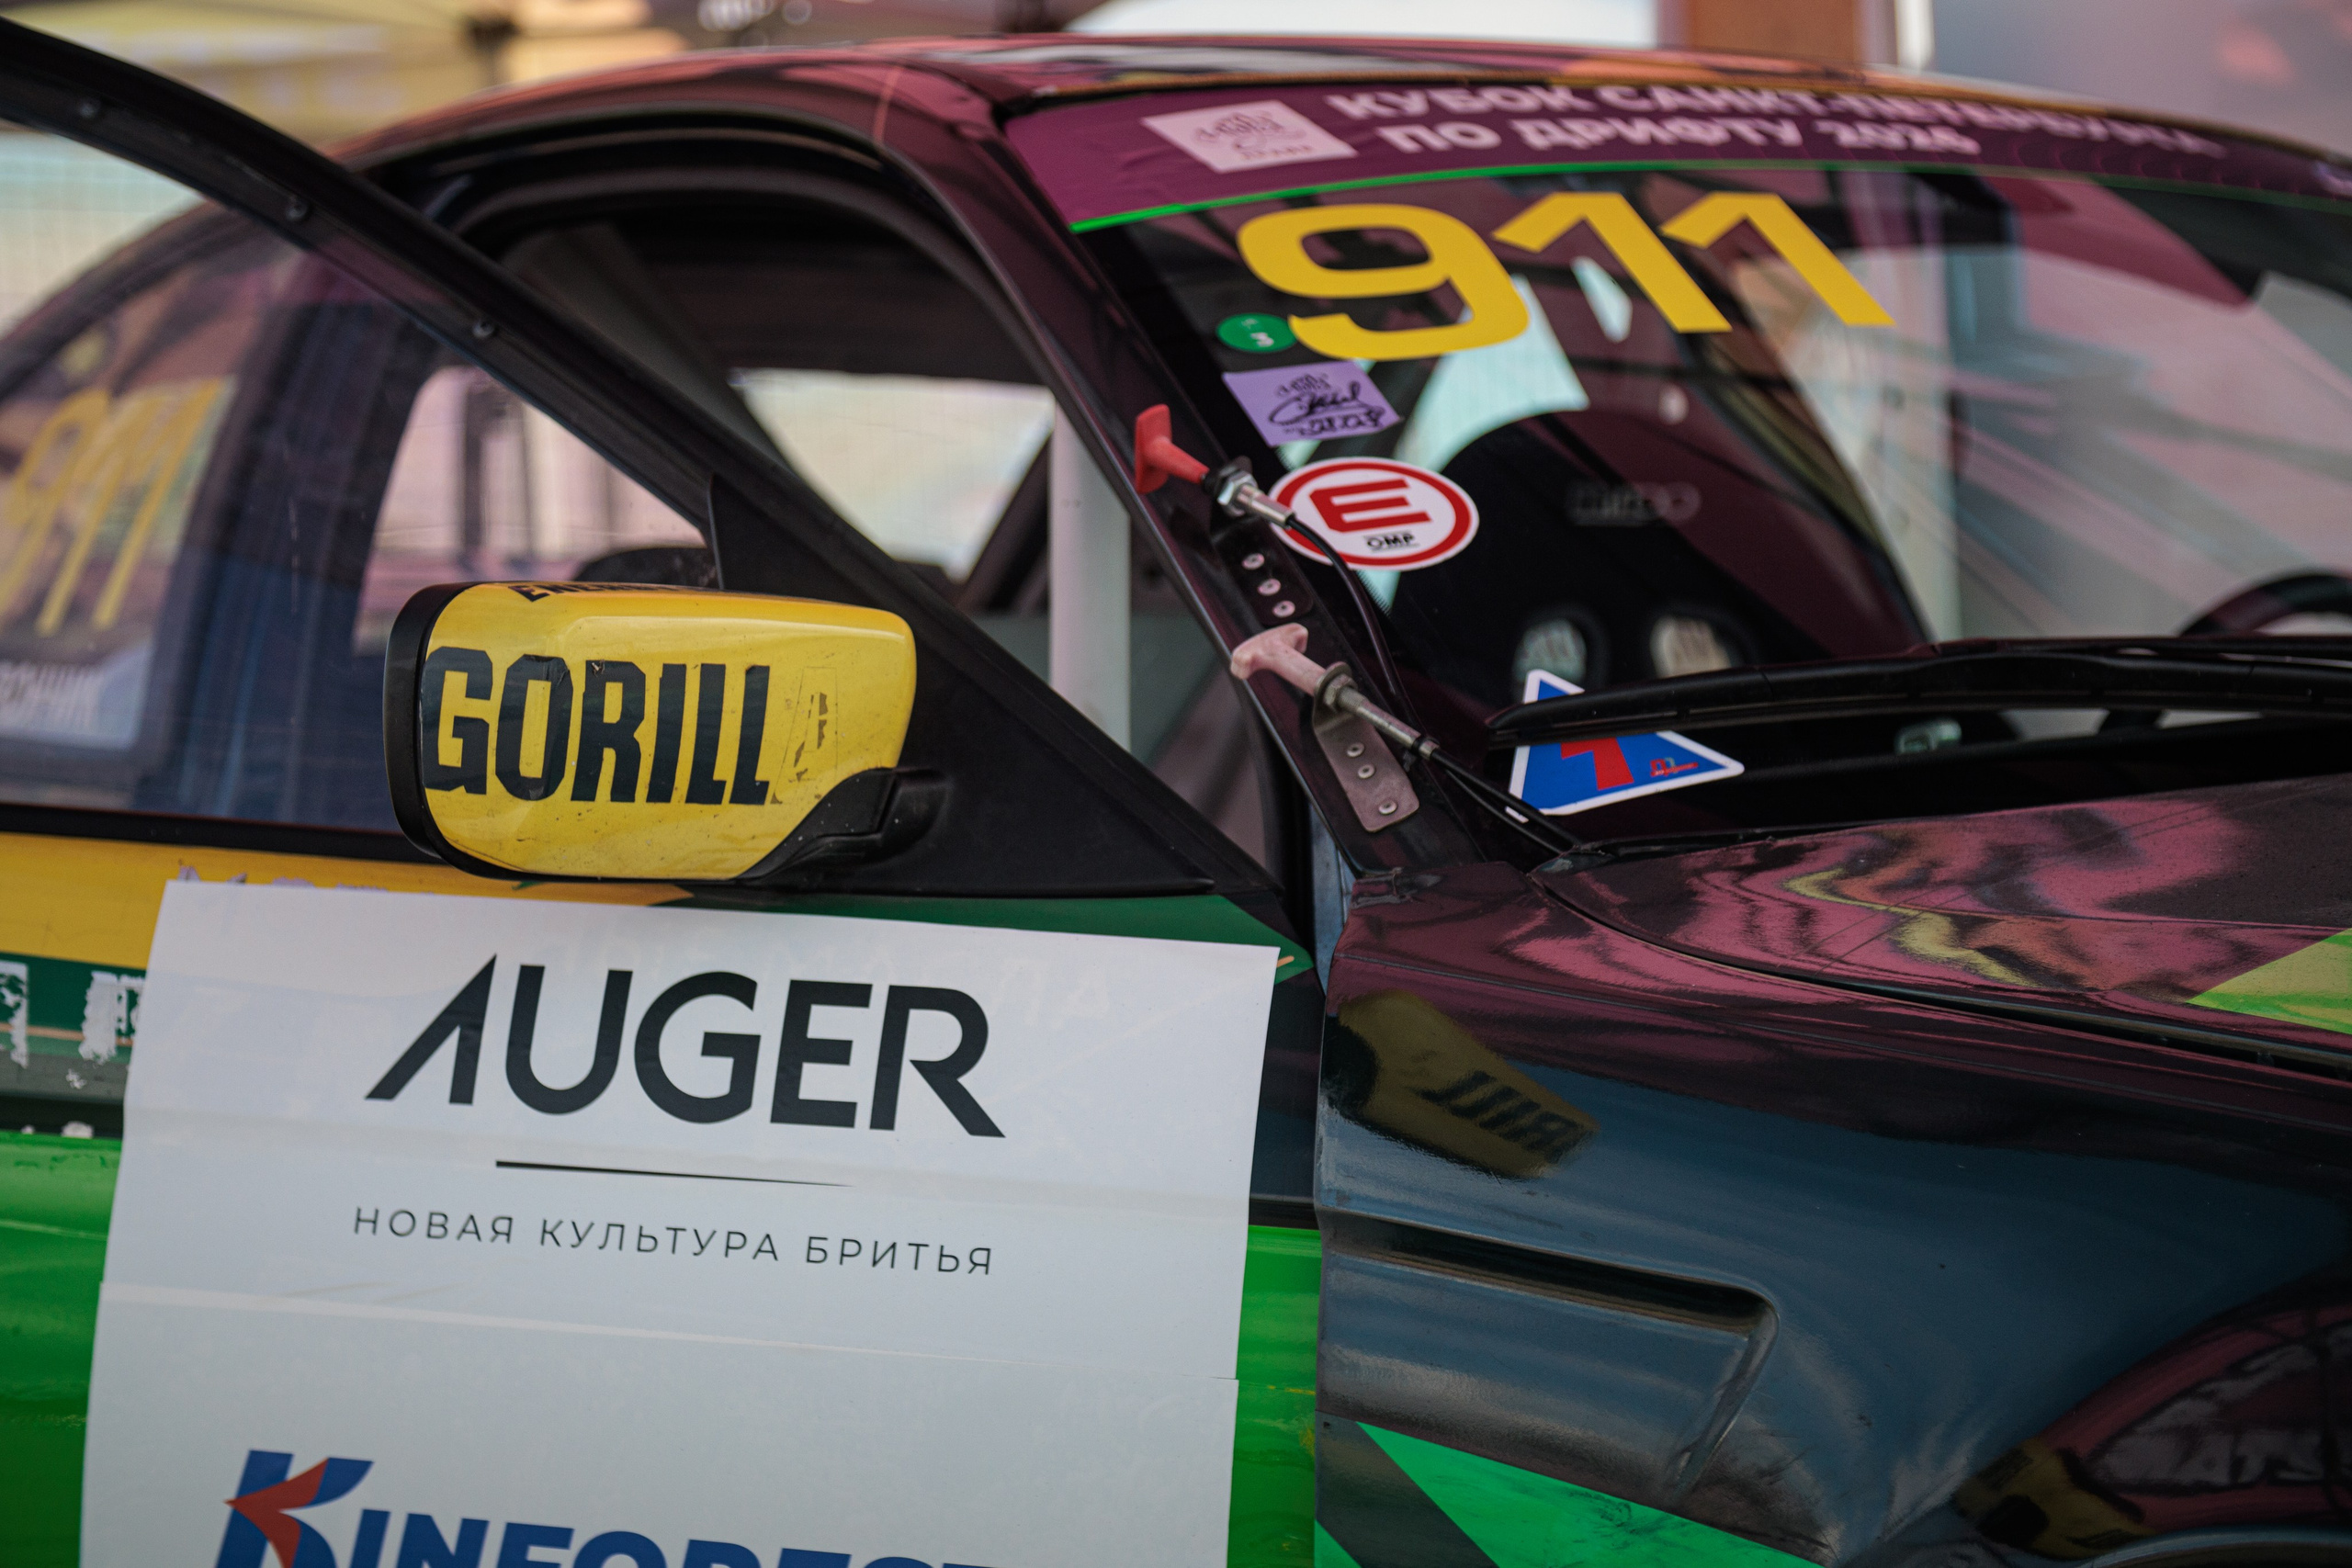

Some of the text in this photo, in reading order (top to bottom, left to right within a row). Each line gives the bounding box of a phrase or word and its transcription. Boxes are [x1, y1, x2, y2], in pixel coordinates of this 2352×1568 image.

[1324, 85, 1600, 119] КУБОК
[1375, 120, 1502, 153] ПО
[1508, 117, 1803, 152] ДРИФТУ
[1238, 191, 1895, 361] 911
[1365, 533, 1417, 551] OMP
[421, 646, 838, 806] GORILL
[364, 953, 1006, 1139] AUGER
[353, 1207, 992, 1275] НОВАЯ КУЛЬТУРА БРИТЬЯ
